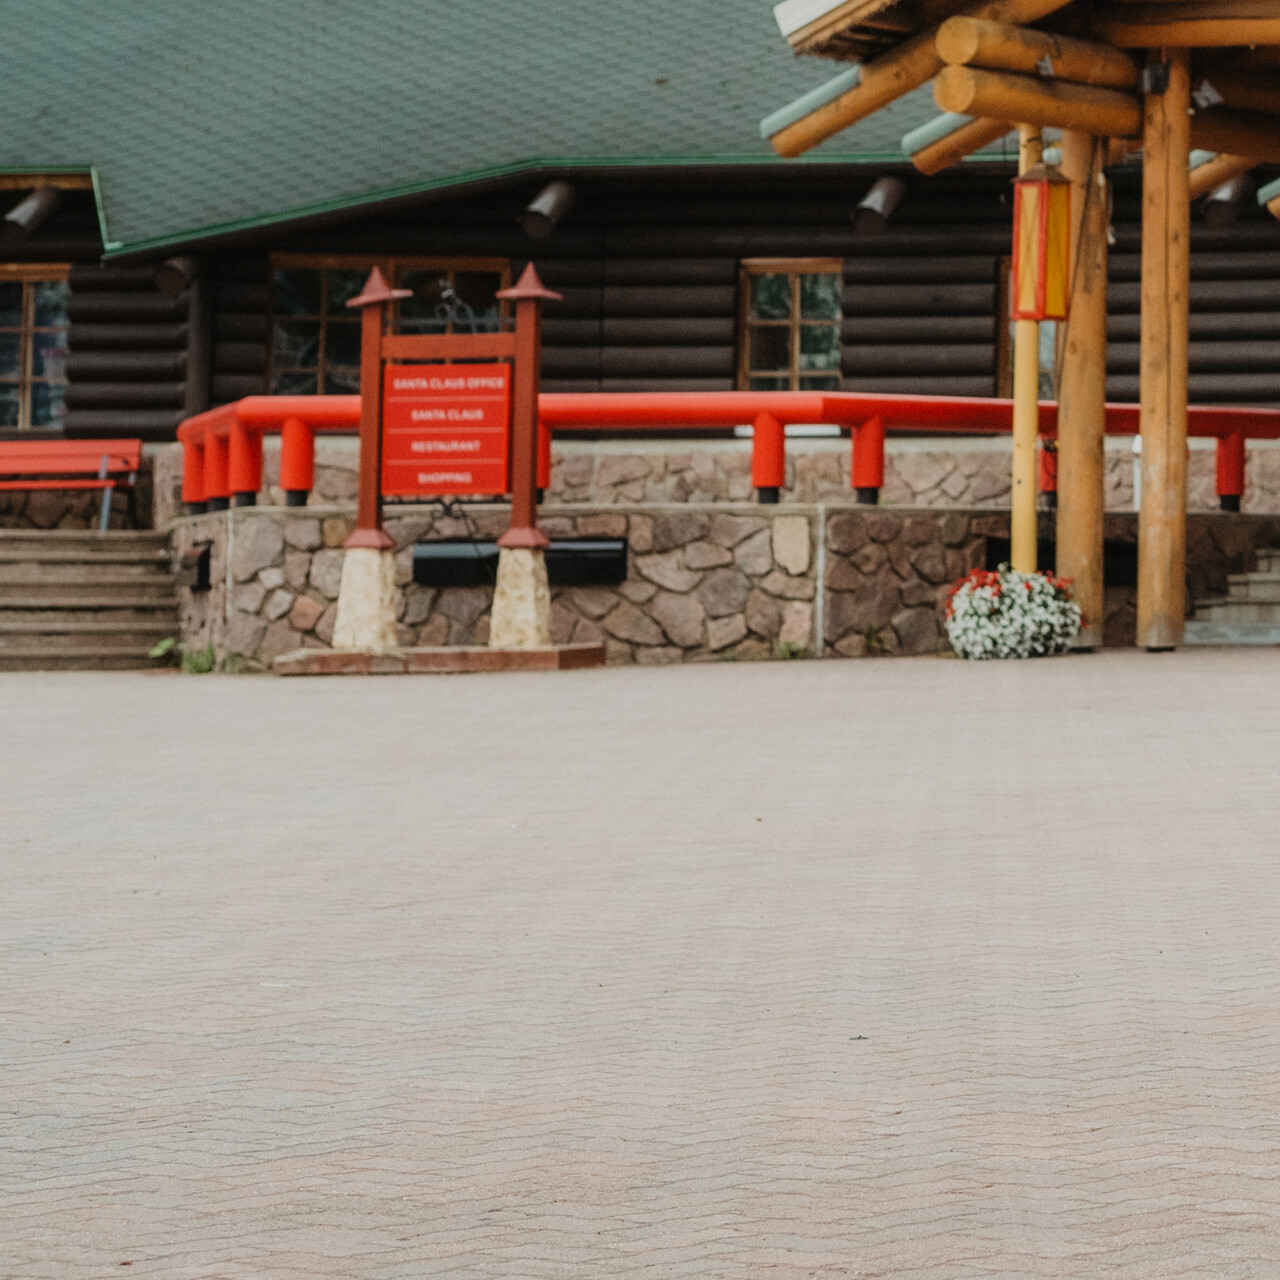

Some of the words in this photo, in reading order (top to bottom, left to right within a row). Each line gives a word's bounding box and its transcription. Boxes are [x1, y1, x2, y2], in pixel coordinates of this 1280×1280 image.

[394, 378, 428, 390] SANTA
[429, 377, 465, 390] CLAUS
[466, 376, 504, 389] OFFICE
[411, 409, 446, 421] SANTA
[447, 408, 484, 420] CLAUS
[411, 440, 481, 452] RESTAURANT
[418, 472, 472, 484] SHOPPING
